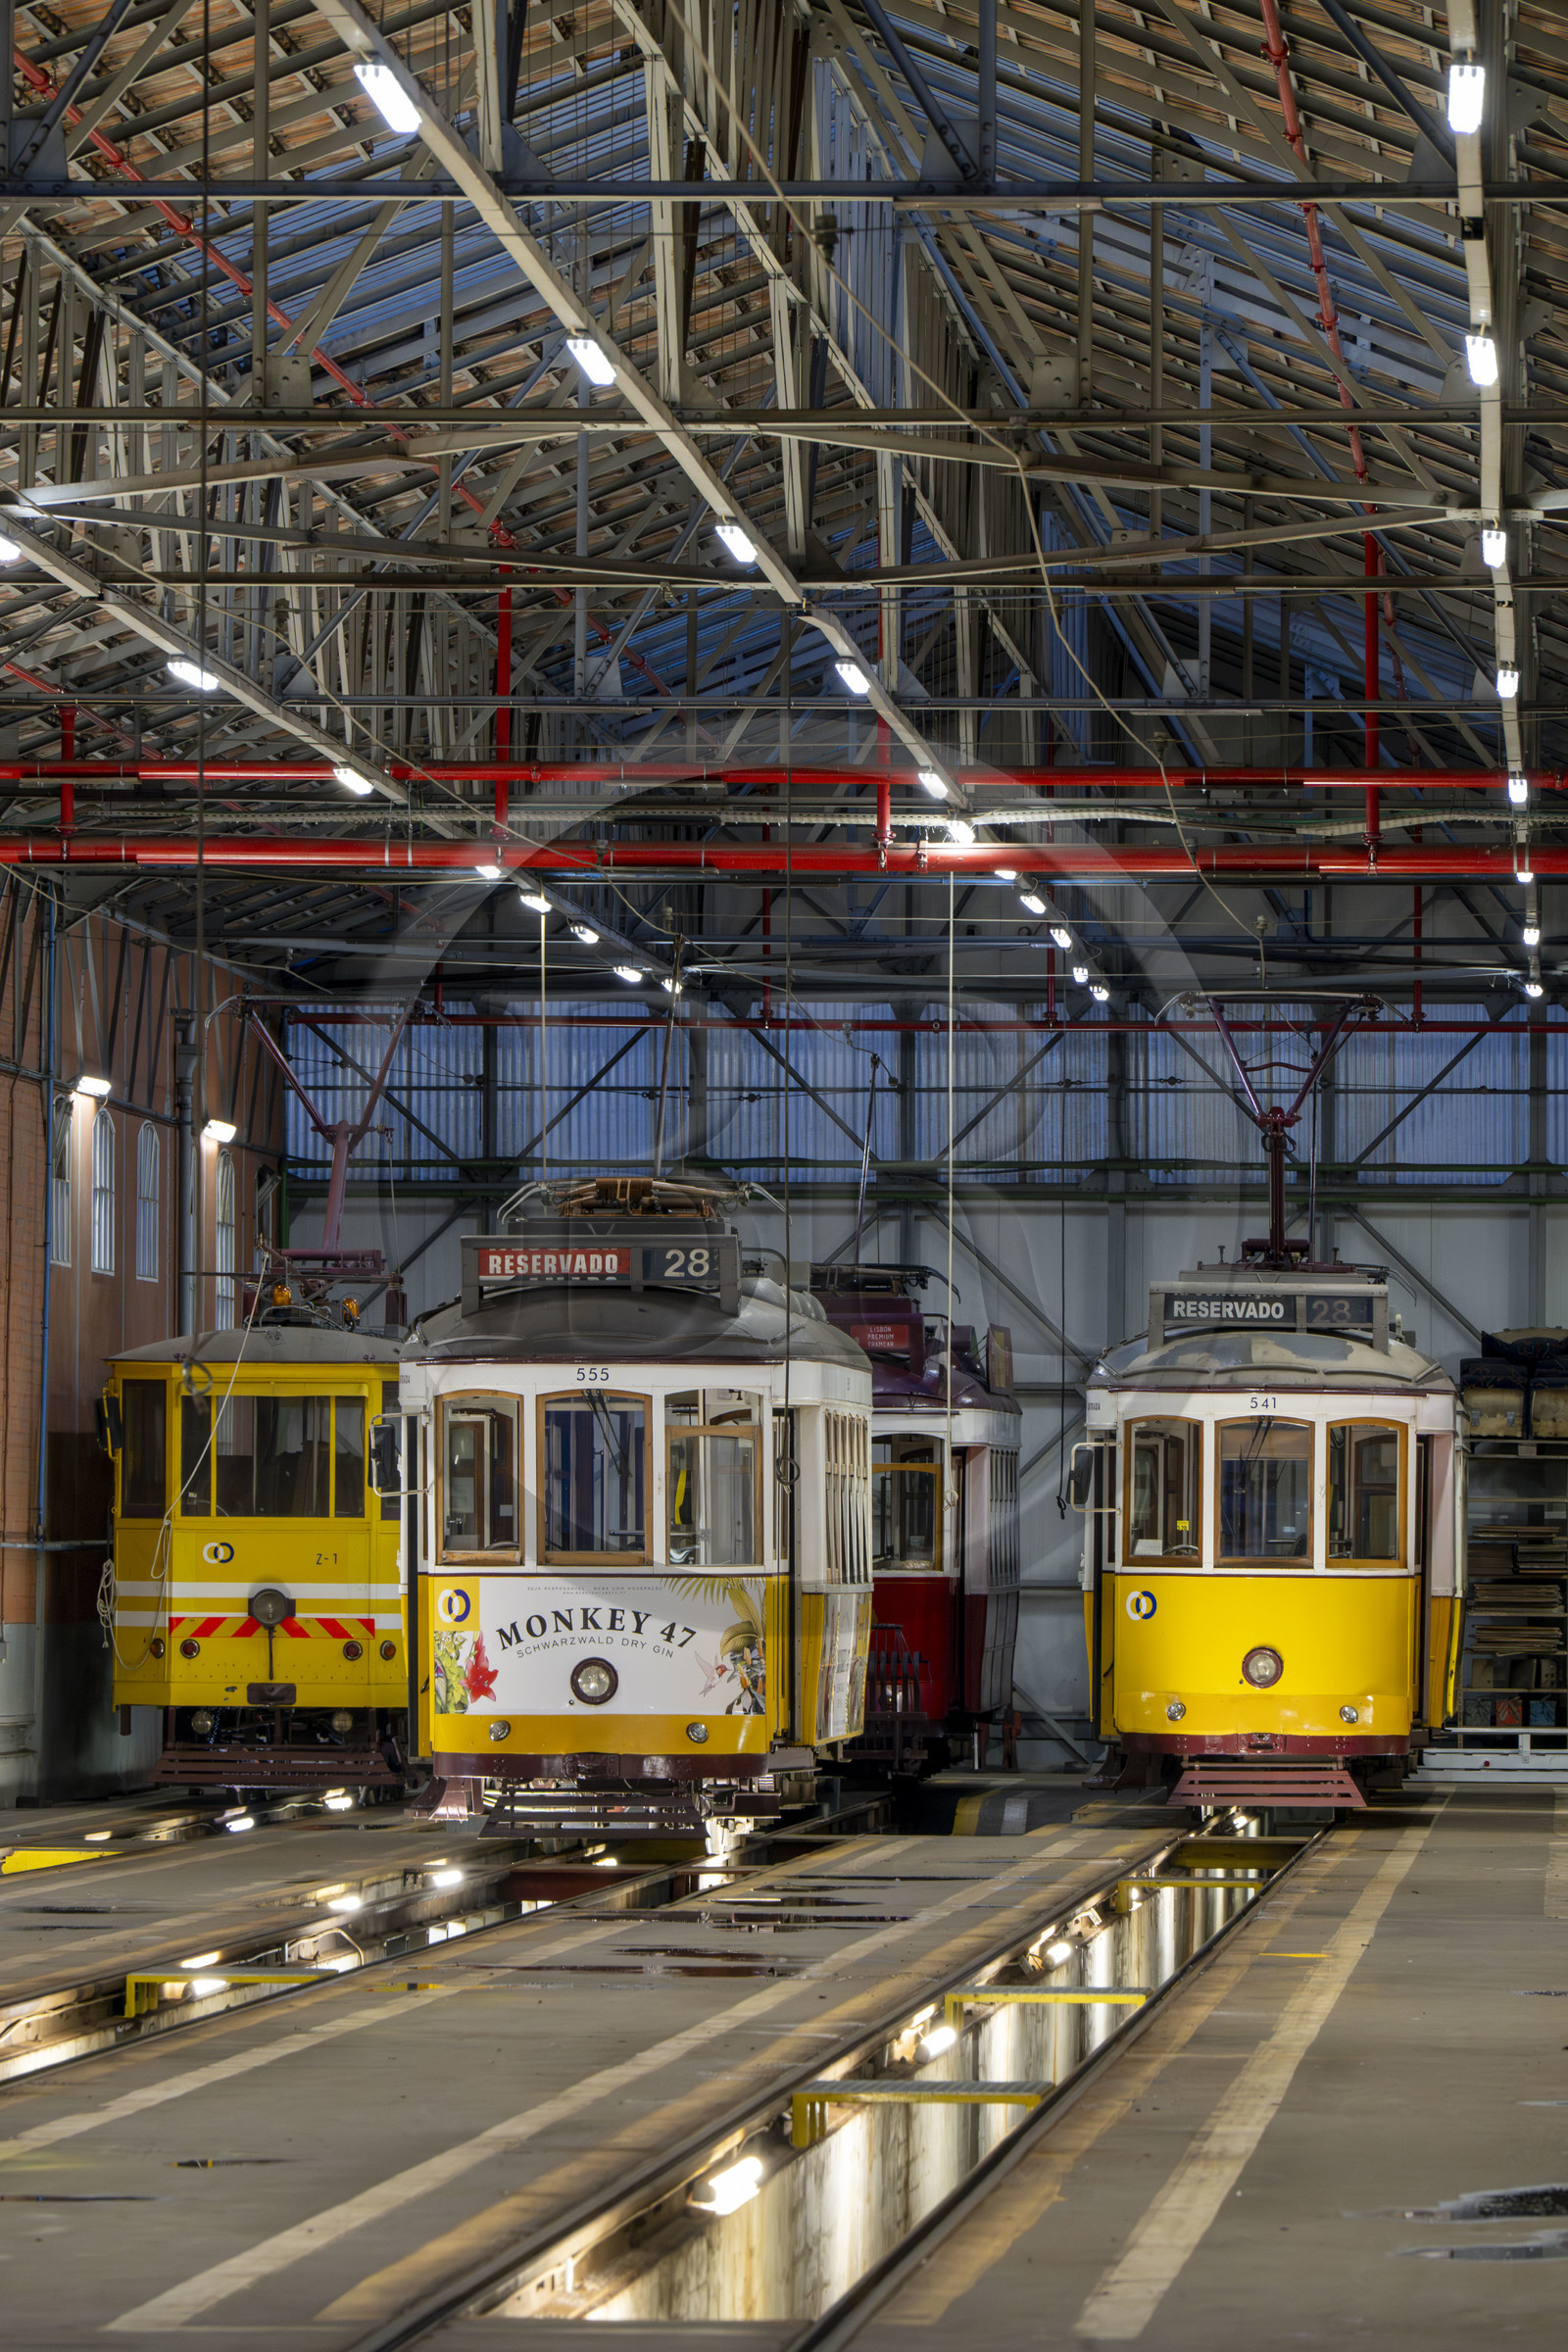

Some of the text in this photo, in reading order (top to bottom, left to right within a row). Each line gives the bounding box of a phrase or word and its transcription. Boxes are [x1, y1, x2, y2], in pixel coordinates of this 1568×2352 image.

[489, 1253, 618, 1274] RESERVADO
[663, 1249, 710, 1277] 28
[1173, 1300, 1285, 1319] RESERVADO
[1311, 1299, 1351, 1323] 28
[576, 1367, 610, 1382] 555
[1250, 1396, 1277, 1409] 541
[316, 1552, 337, 1565] Z-1
[496, 1607, 697, 1651] MONKEY 47
[516, 1637, 674, 1659] SCHWARZWALD DRY GIN
